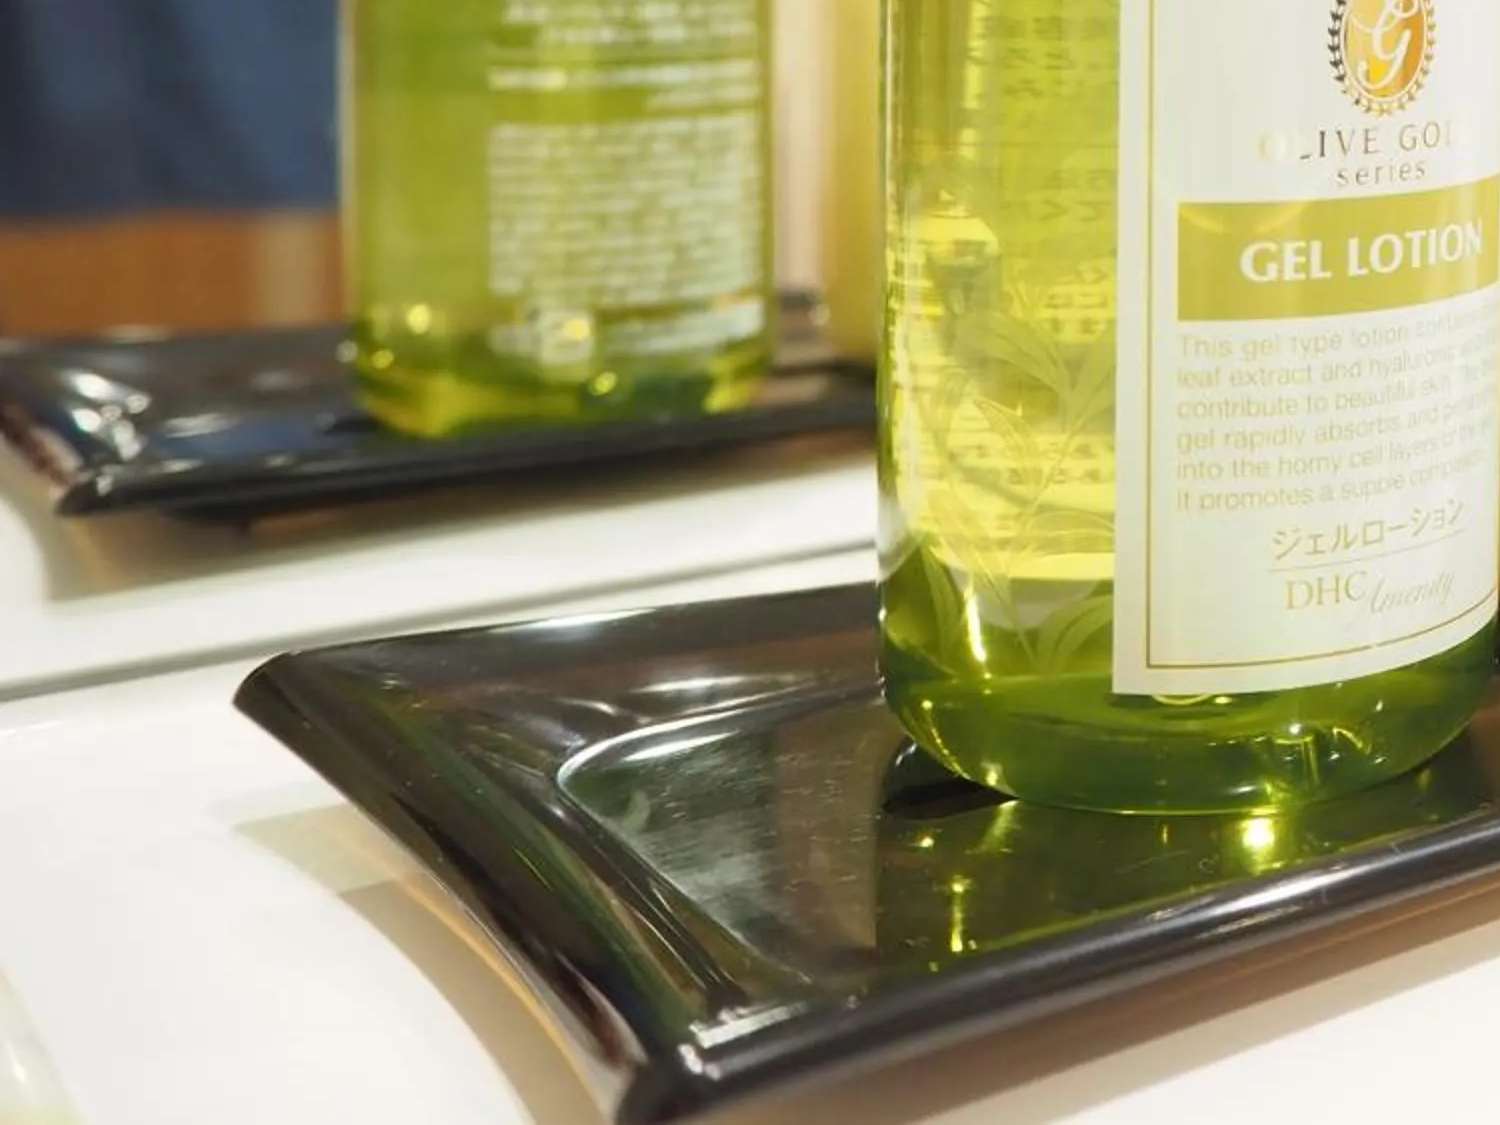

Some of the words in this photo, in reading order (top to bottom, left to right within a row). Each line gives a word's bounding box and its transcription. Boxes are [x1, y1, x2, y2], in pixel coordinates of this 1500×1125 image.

[1336, 160, 1425, 186] series
[1239, 240, 1332, 284] GEL
[1347, 220, 1484, 279] LOTION
[1230, 362, 1313, 387] extract
[1321, 357, 1363, 382] and
[1177, 396, 1299, 420] contribute
[1307, 393, 1329, 413] to
[1177, 428, 1215, 455] gel
[1224, 423, 1305, 453] rapidly
[1177, 459, 1224, 480] into
[1232, 457, 1272, 479] the
[1199, 486, 1314, 514] promotes
[1271, 497, 1465, 561] ジェルローション
[1285, 570, 1368, 611] DHC
